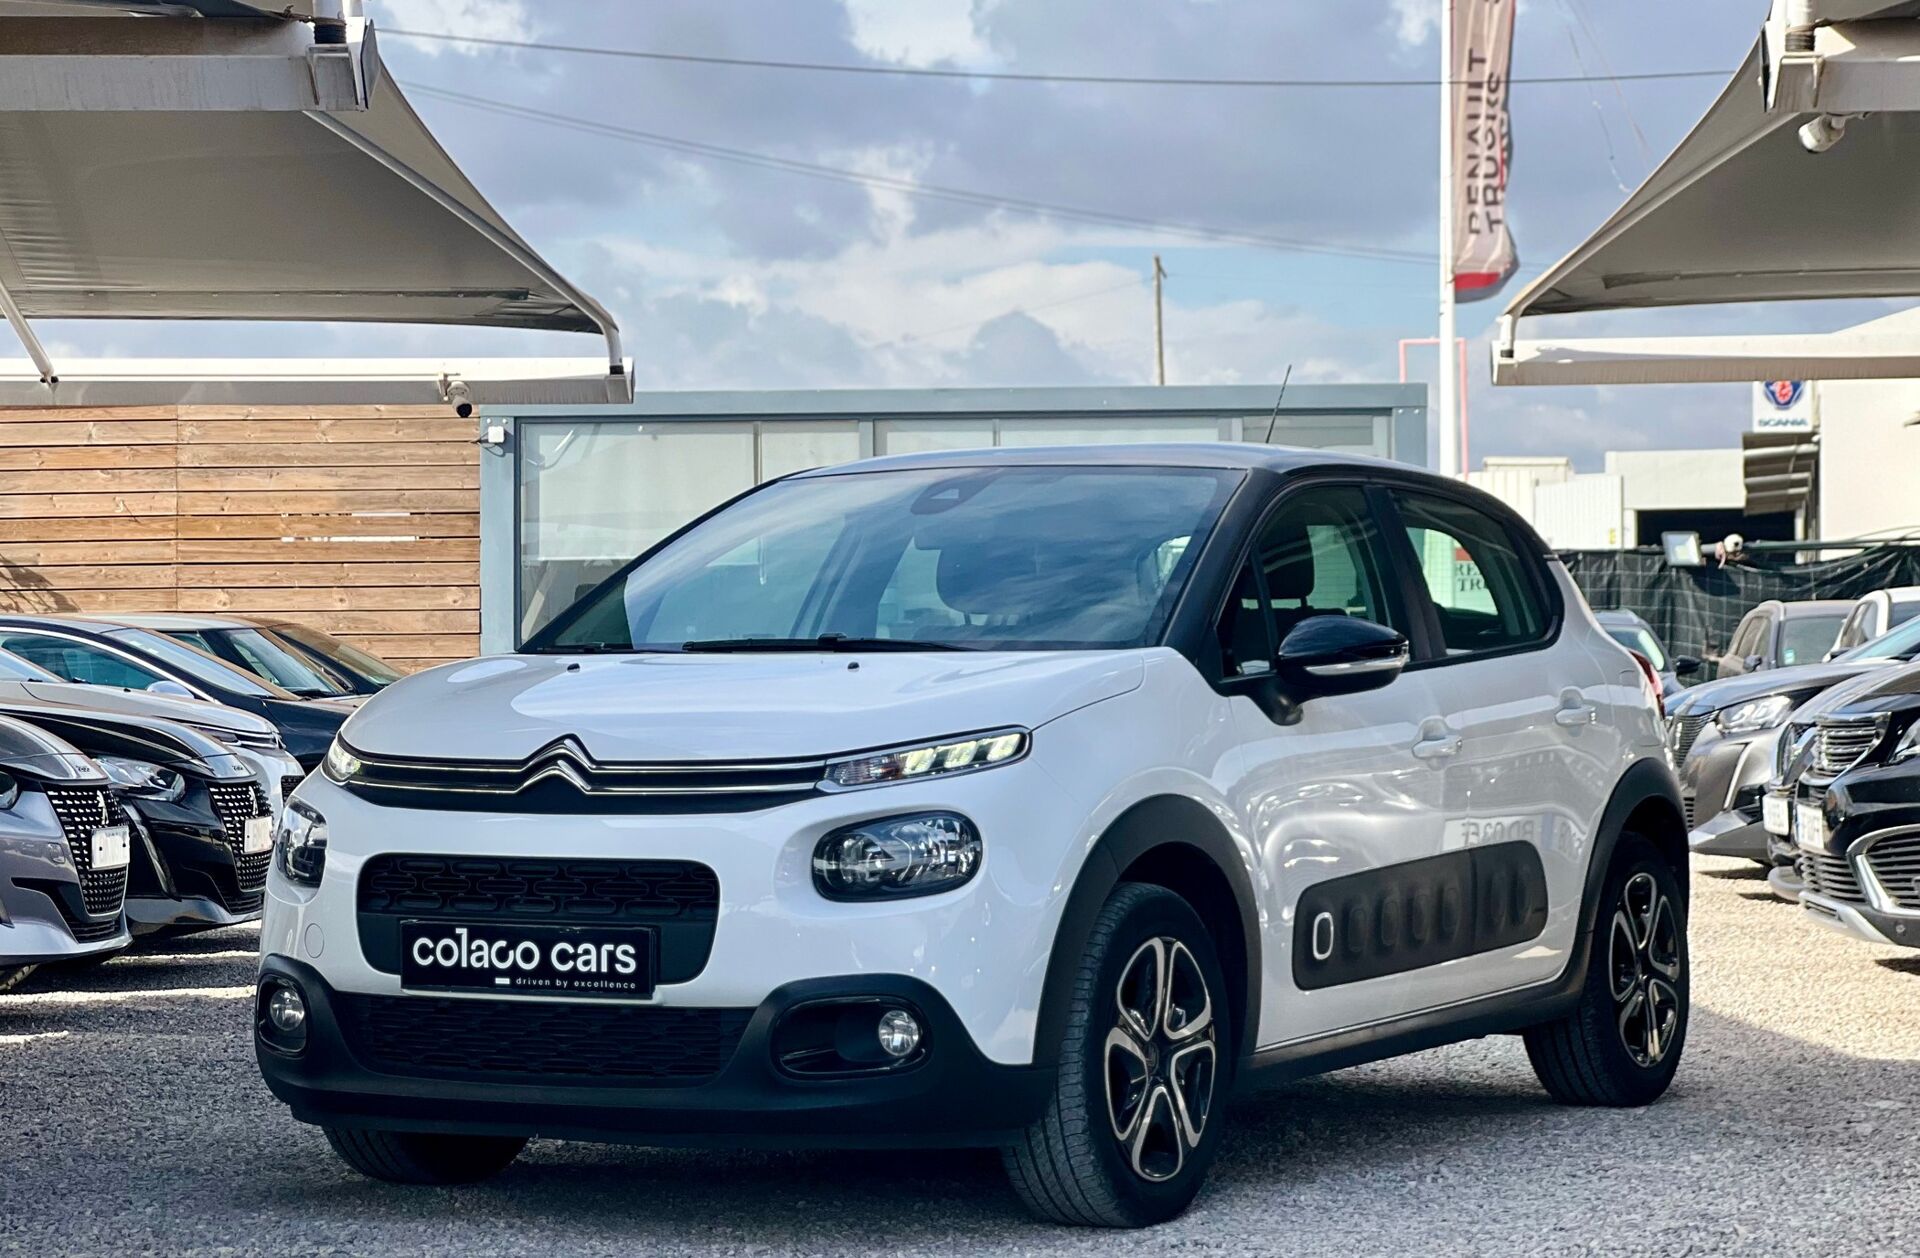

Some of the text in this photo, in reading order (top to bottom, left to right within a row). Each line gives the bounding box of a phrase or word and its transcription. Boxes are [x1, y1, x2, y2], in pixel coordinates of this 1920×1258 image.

[1758, 418, 1808, 426] SCANIA
[550, 941, 637, 974] cars
[516, 977, 637, 989] driven by excellence
